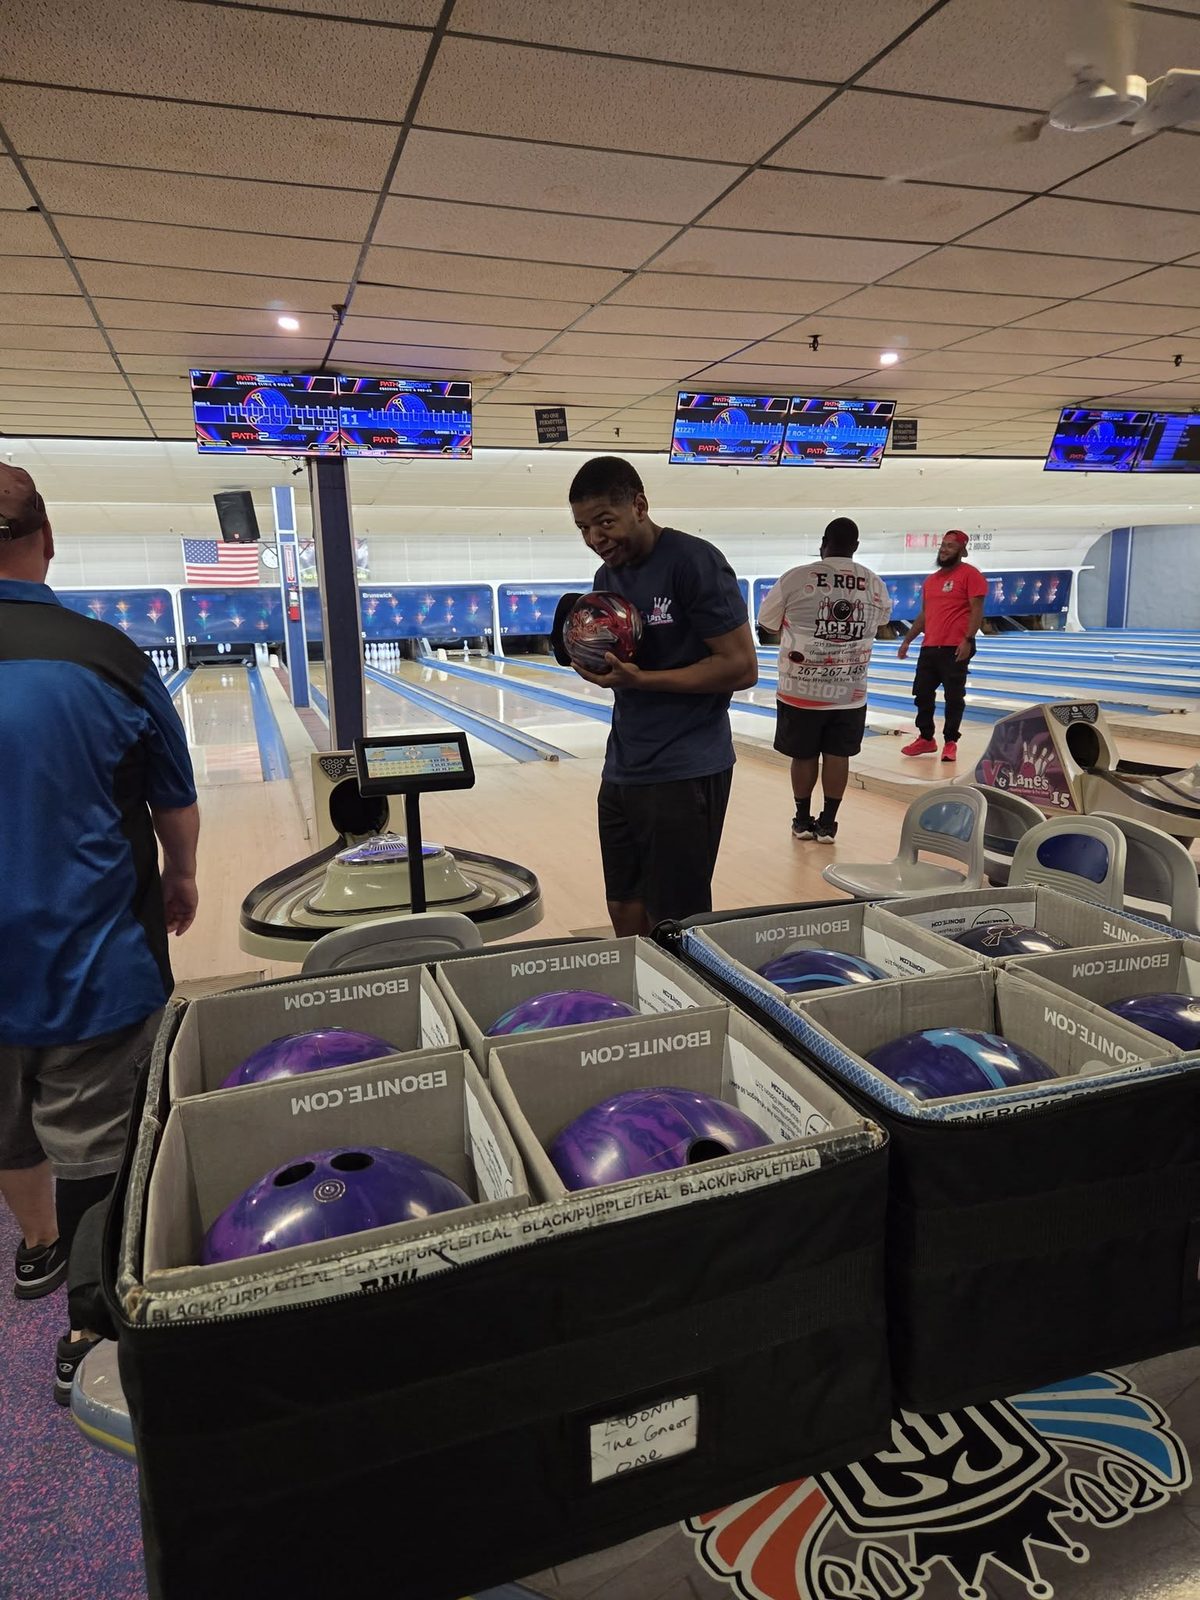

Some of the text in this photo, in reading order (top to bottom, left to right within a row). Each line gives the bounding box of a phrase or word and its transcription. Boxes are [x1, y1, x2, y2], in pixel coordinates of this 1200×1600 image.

[817, 573, 866, 591] E ROC
[814, 620, 865, 638] ACE IT
[798, 680, 848, 698] SHOP
[1008, 772, 1049, 790] Lanes
[1052, 791, 1070, 808] 15
[755, 920, 850, 944] EBONITE.COM
[511, 950, 620, 978] EBONITE.COM
[1072, 953, 1170, 978] EBONITE.COM
[284, 978, 409, 1011] EBONITE.COM
[580, 1030, 711, 1067] EBONITE.COM
[291, 1069, 448, 1116] EBONITE.COM
[680, 1156, 816, 1198] BLACK/PURPLE/TEAL
[522, 1186, 672, 1235] BLACK/PURPLE/TEAL
[344, 1224, 512, 1283] BLACK/PURPLE/TEAL
[152, 1272, 334, 1322] BLACK/PURPLE/TEAL
